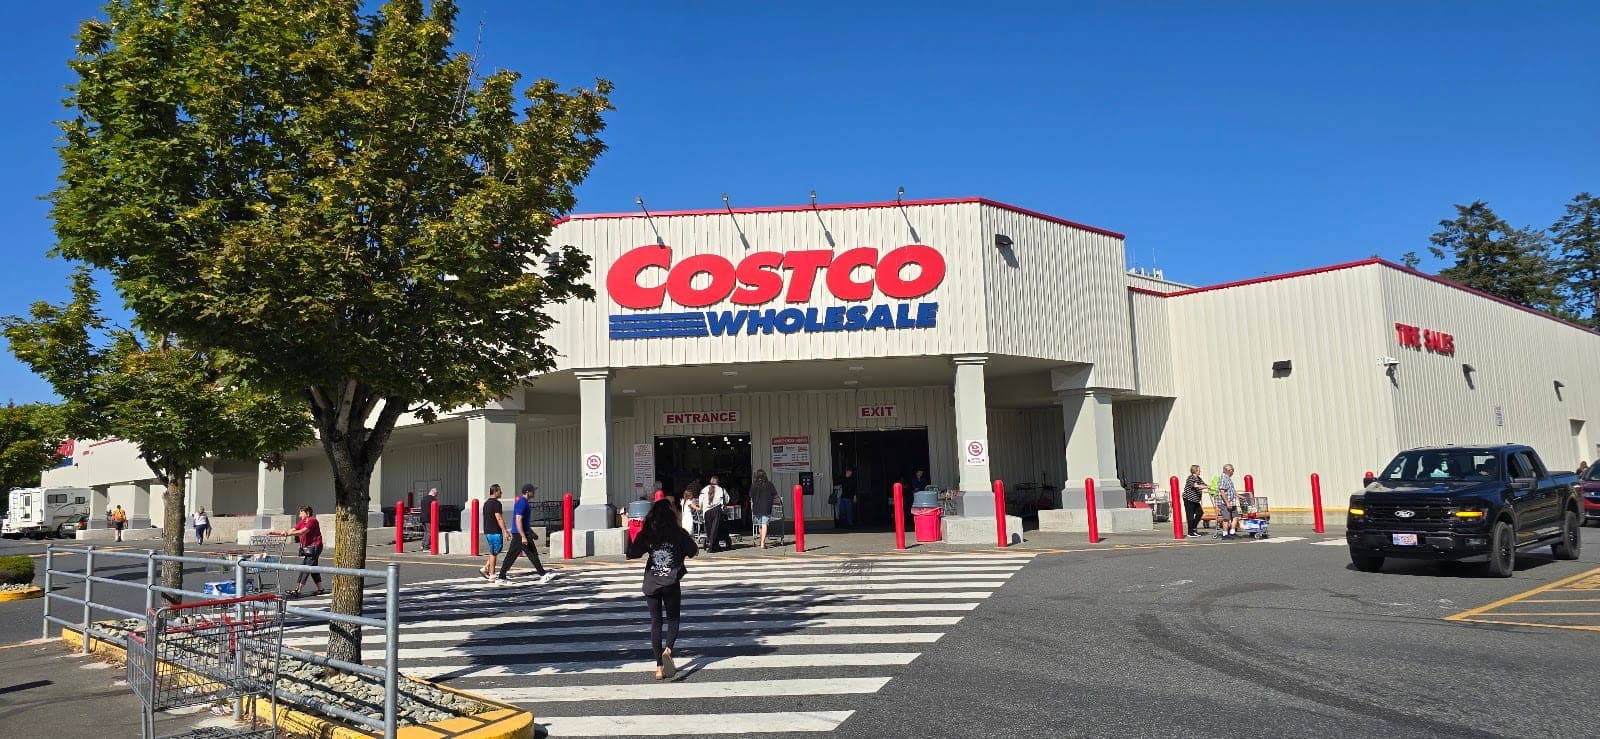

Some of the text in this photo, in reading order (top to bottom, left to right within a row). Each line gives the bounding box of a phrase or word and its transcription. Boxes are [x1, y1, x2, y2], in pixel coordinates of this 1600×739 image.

[606, 244, 946, 309] COSTCO
[706, 302, 939, 337] WHOLESALE
[1394, 322, 1455, 357] TIRE SALES
[666, 411, 737, 424] ENTRANCE
[861, 406, 894, 417] EXIT
